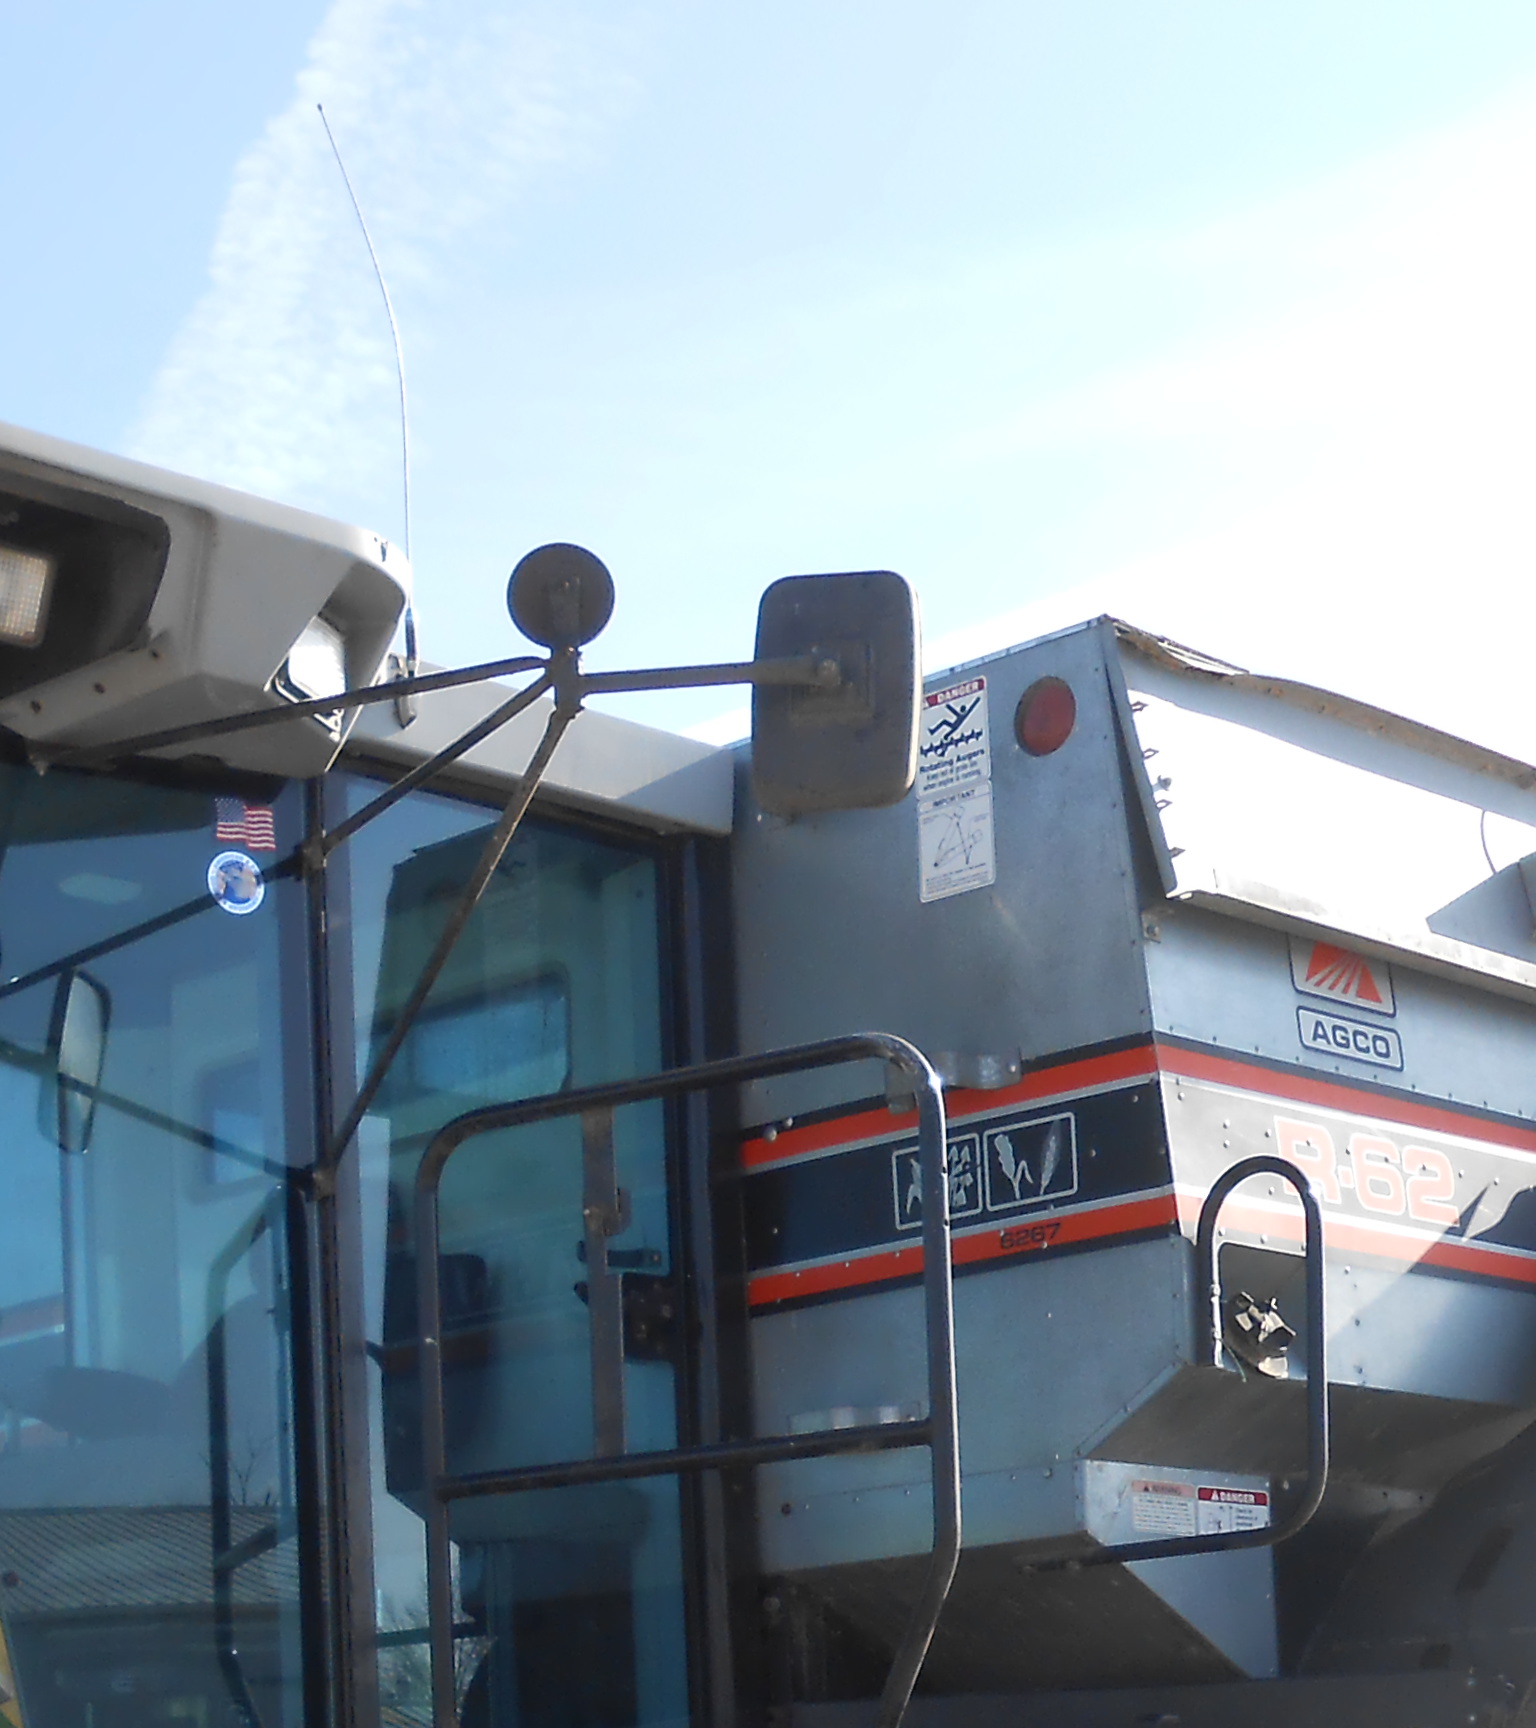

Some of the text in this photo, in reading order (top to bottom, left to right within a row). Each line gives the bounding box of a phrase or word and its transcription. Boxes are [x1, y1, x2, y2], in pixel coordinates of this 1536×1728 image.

[937, 682, 980, 703] DANGER
[1312, 1020, 1391, 1059] AGCO
[1273, 1114, 1461, 1228] R-62
[1220, 1491, 1255, 1504] DANGER
